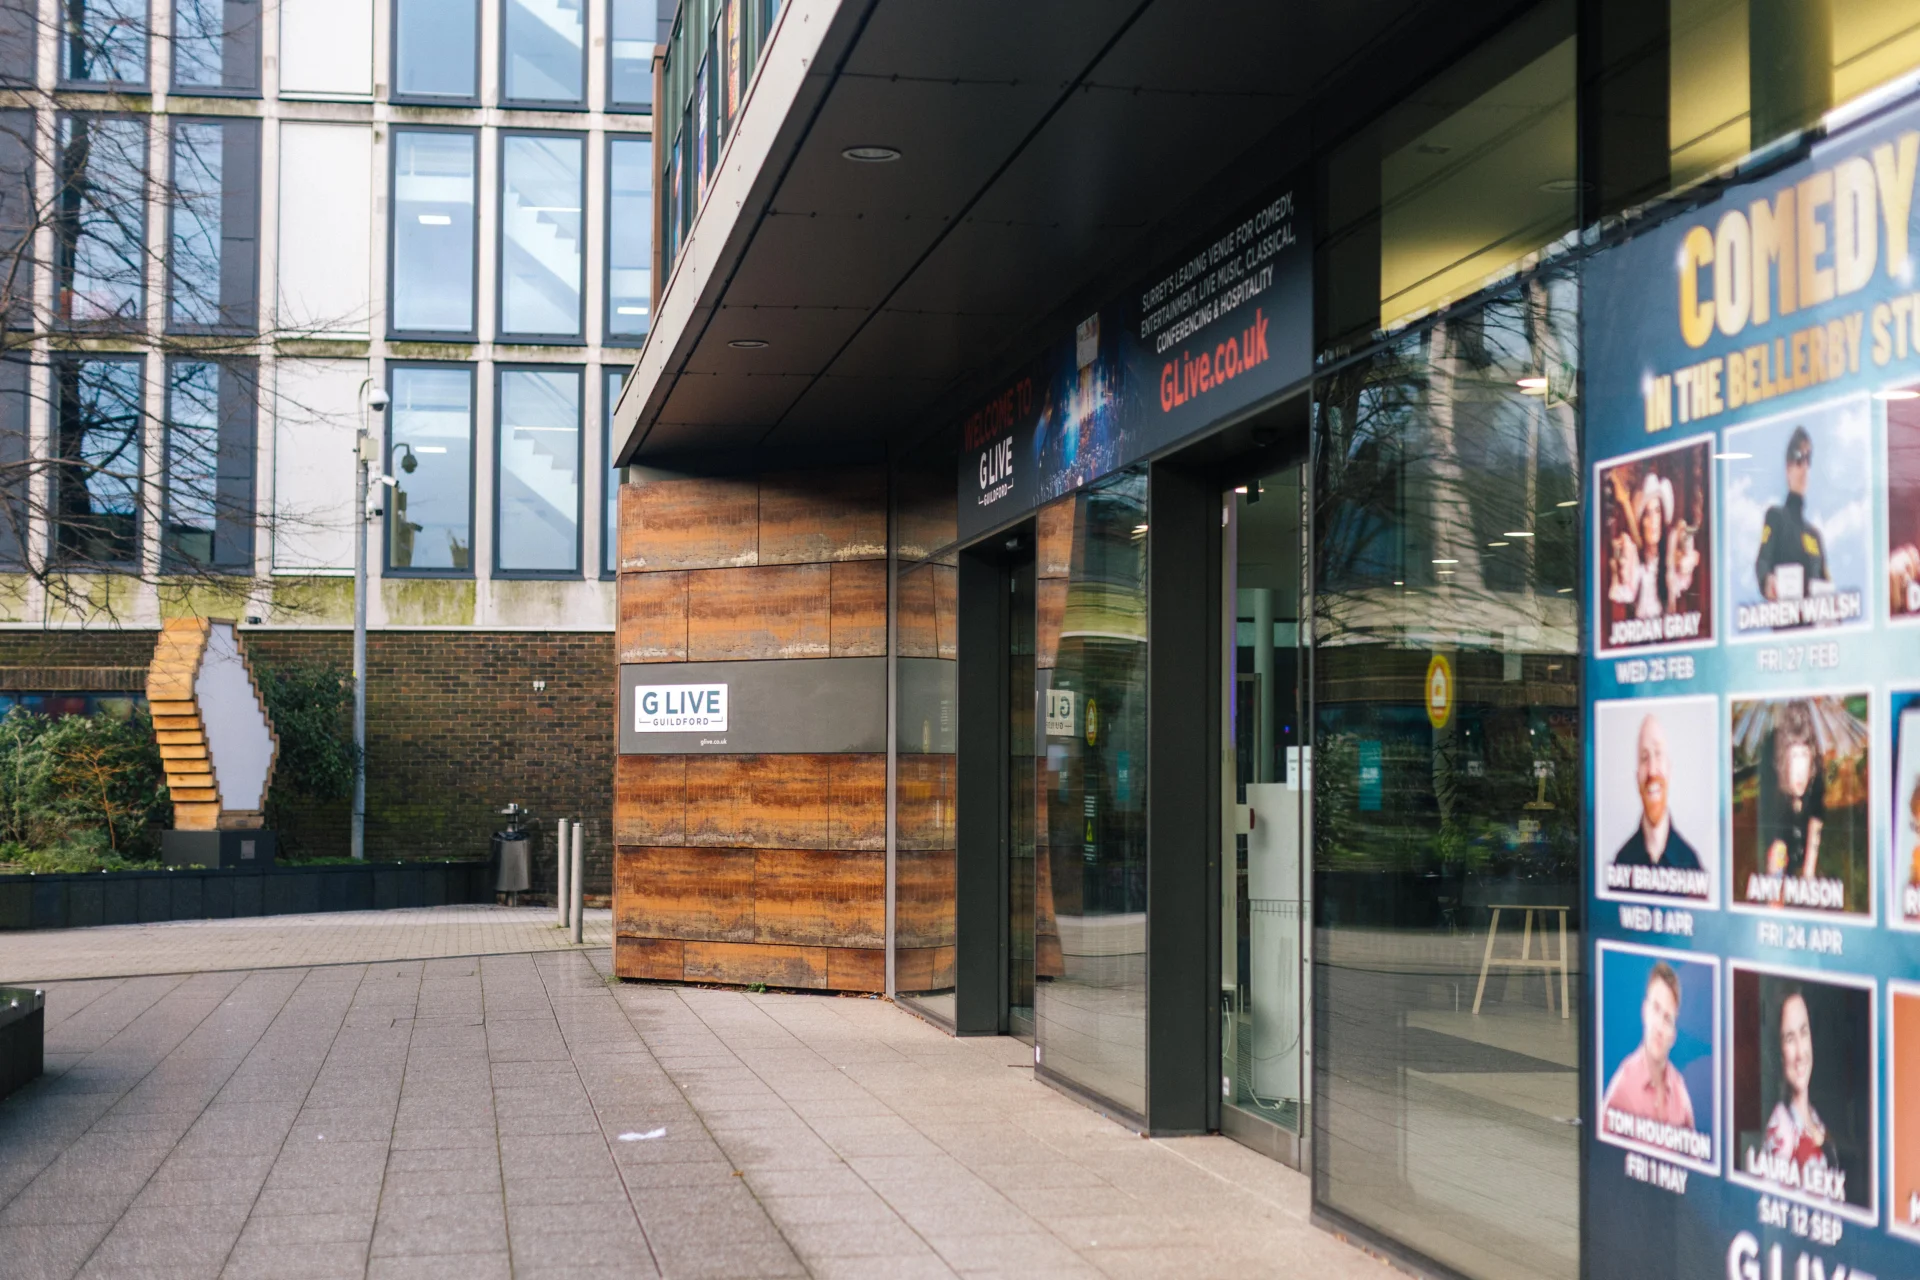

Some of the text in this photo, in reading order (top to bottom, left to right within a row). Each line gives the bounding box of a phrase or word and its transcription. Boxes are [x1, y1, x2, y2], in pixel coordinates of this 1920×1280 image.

[1143, 190, 1294, 312] SURREY'S LEADING VENUE FOR COMEDY,
[1679, 131, 1919, 348] COMEDY
[1141, 223, 1296, 339] ENTERTAINMENT, LIVE MUSIC, CLASSICAL,
[1156, 264, 1274, 353] CONFERENCING & HOSPITALITY
[1160, 308, 1269, 412] GLive.co.uk
[1645, 374, 1672, 433] IN
[1675, 358, 1723, 423] THE
[1727, 312, 1863, 409] BELLERBY
[965, 377, 1031, 452] WELCOME TO
[984, 483, 1008, 506] GUILDFORD
[1609, 612, 1702, 645] JORDAN GRAY
[1738, 592, 1860, 630] DARREN WALSH
[1615, 656, 1695, 684] WED 25 FEB
[1759, 643, 1839, 673] FRI 27 FEB
[653, 717, 709, 726] GUILDFORD
[700, 738, 727, 746] glive.co.uk
[1607, 865, 1709, 895] RAY BRADSHAW
[1747, 873, 1844, 908] AMY MASON
[1620, 906, 1693, 936] WED 8 APR
[1758, 922, 1843, 955] FRI 24 APR
[1607, 1110, 1711, 1159] TOM HOUGHTON
[1626, 1152, 1688, 1194] FRI 1 MAY
[1747, 1145, 1845, 1201] LAURA LEXX
[1759, 1194, 1843, 1246] SAT 12 SEP
